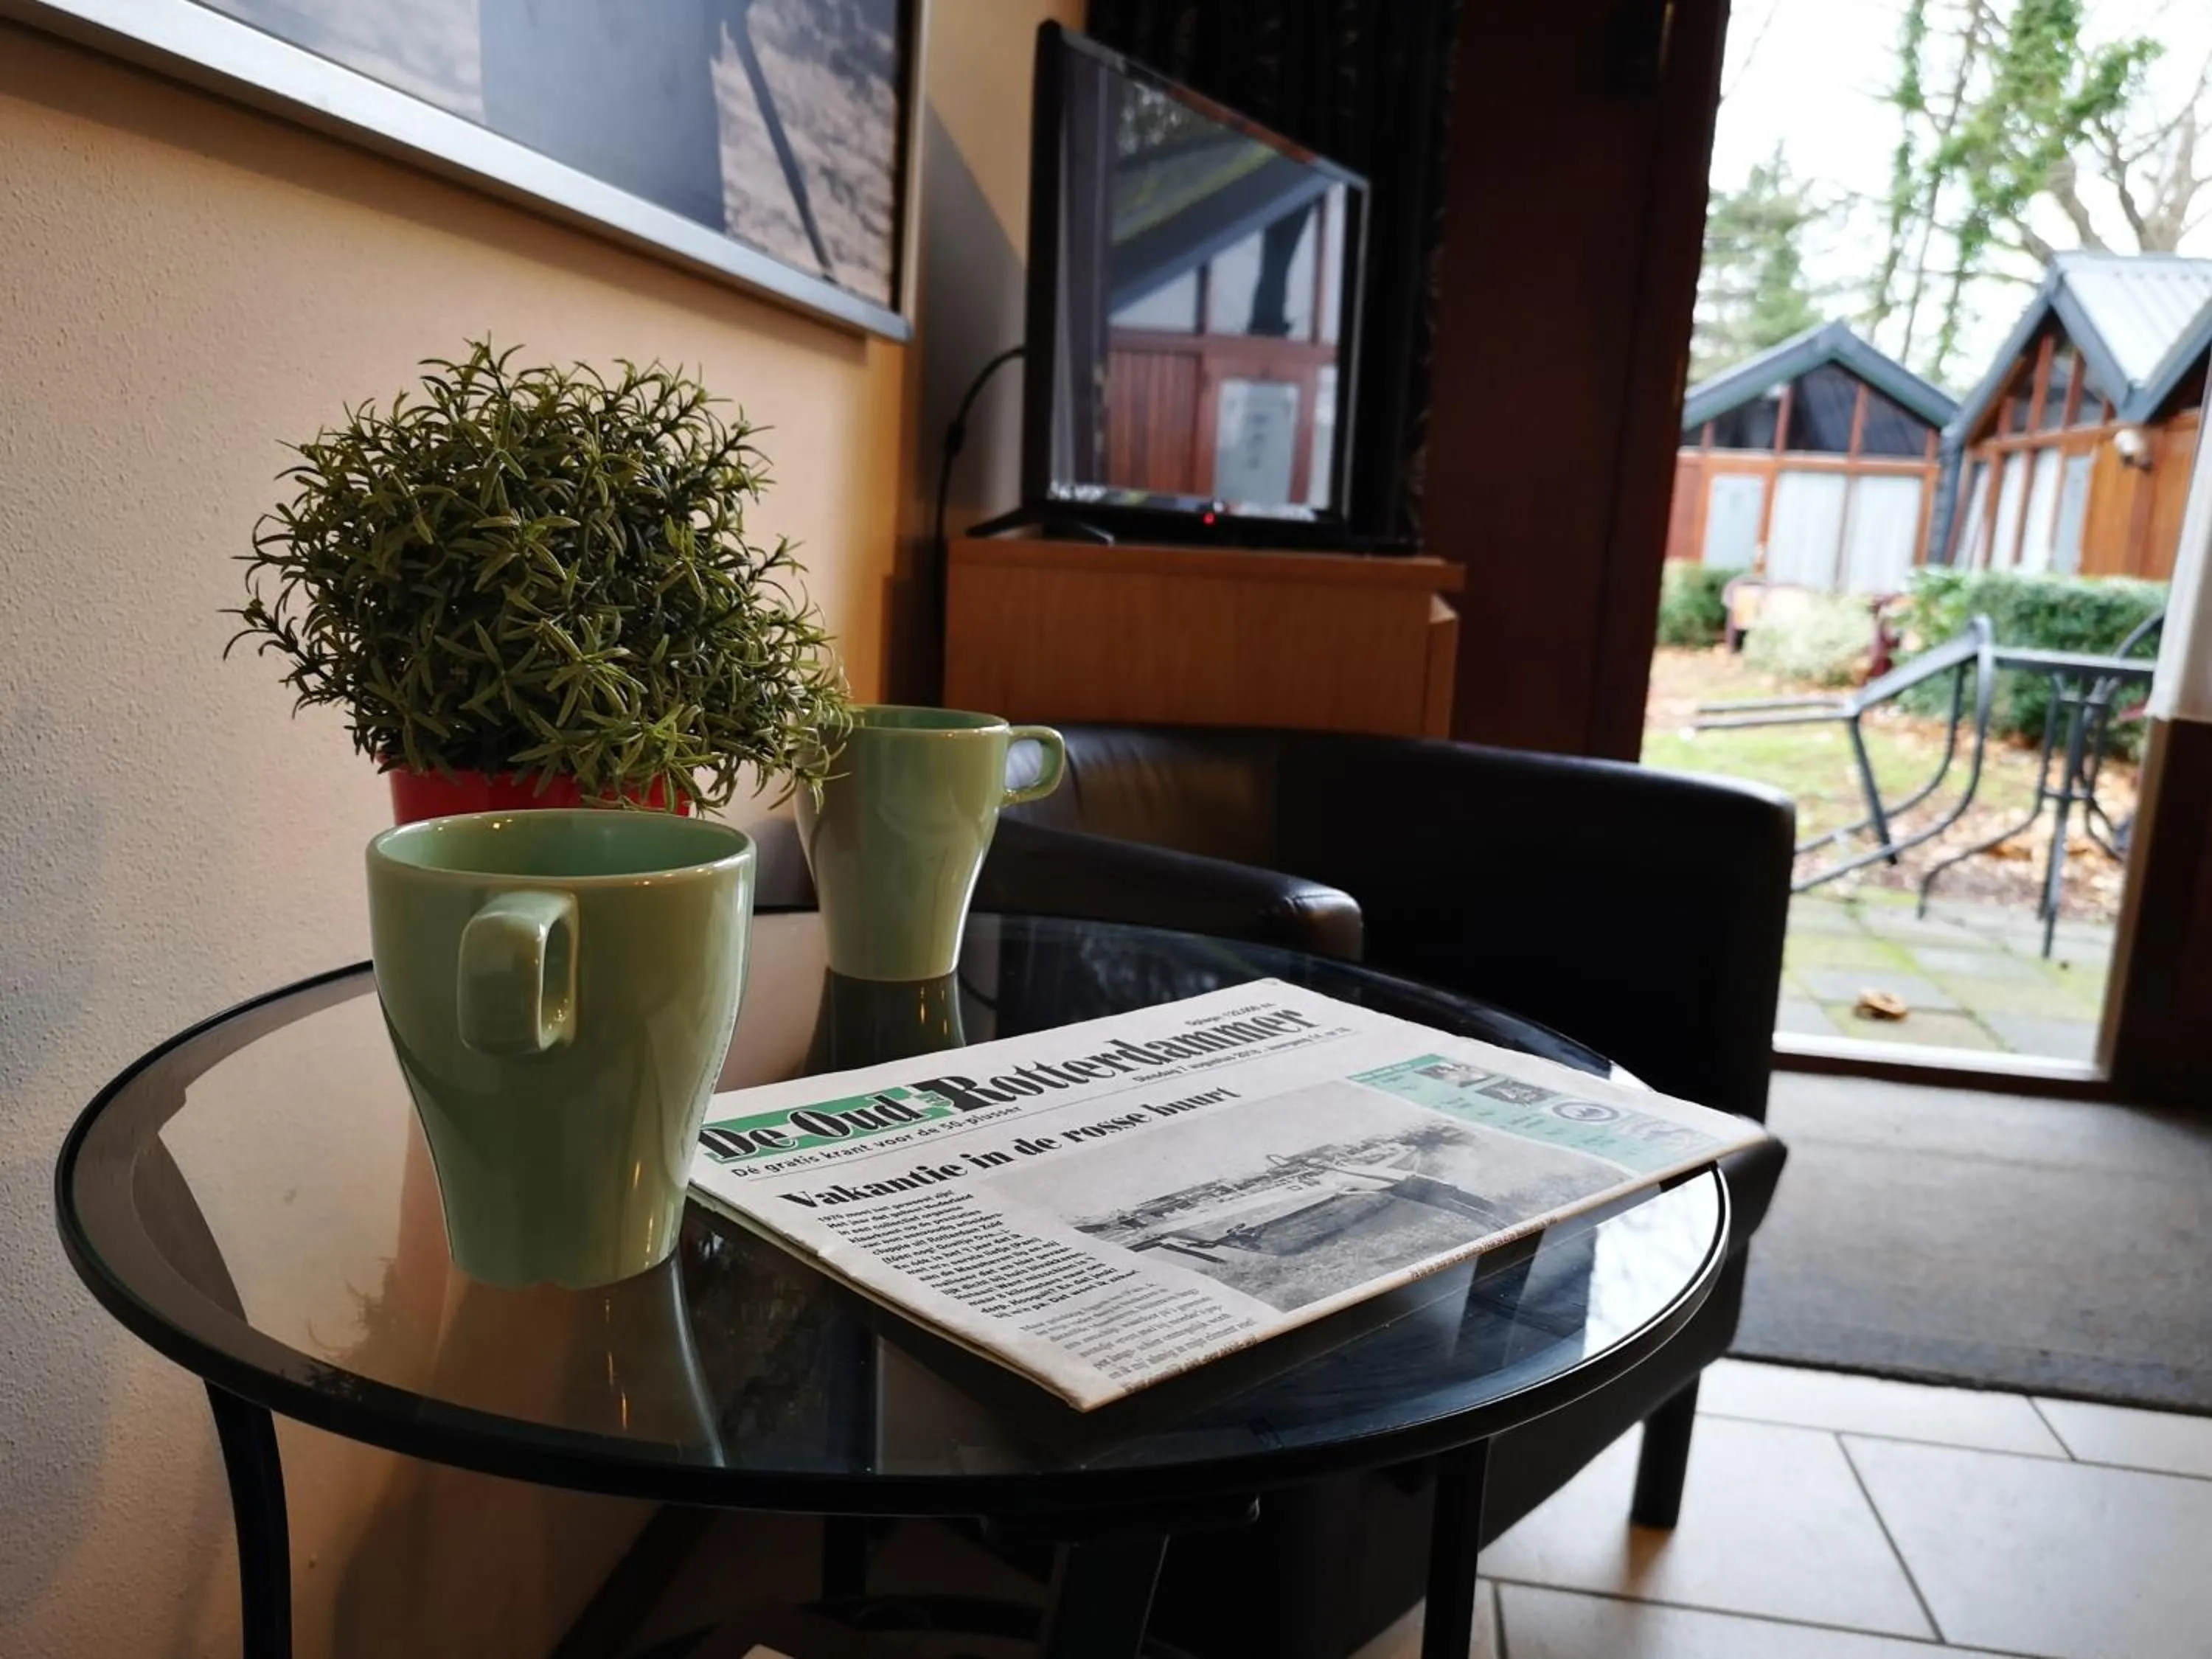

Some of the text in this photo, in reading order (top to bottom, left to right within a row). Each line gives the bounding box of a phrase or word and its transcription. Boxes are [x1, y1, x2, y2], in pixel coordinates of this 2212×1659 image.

[698, 1127, 797, 1159] De
[790, 1094, 925, 1138] Oud
[912, 1009, 1320, 1113] Rotterdammer
[731, 1105, 1023, 1178] Dé gratis krant voor de 50-plusser
[776, 1086, 1243, 1208] Vakantie in de rosse buurt
